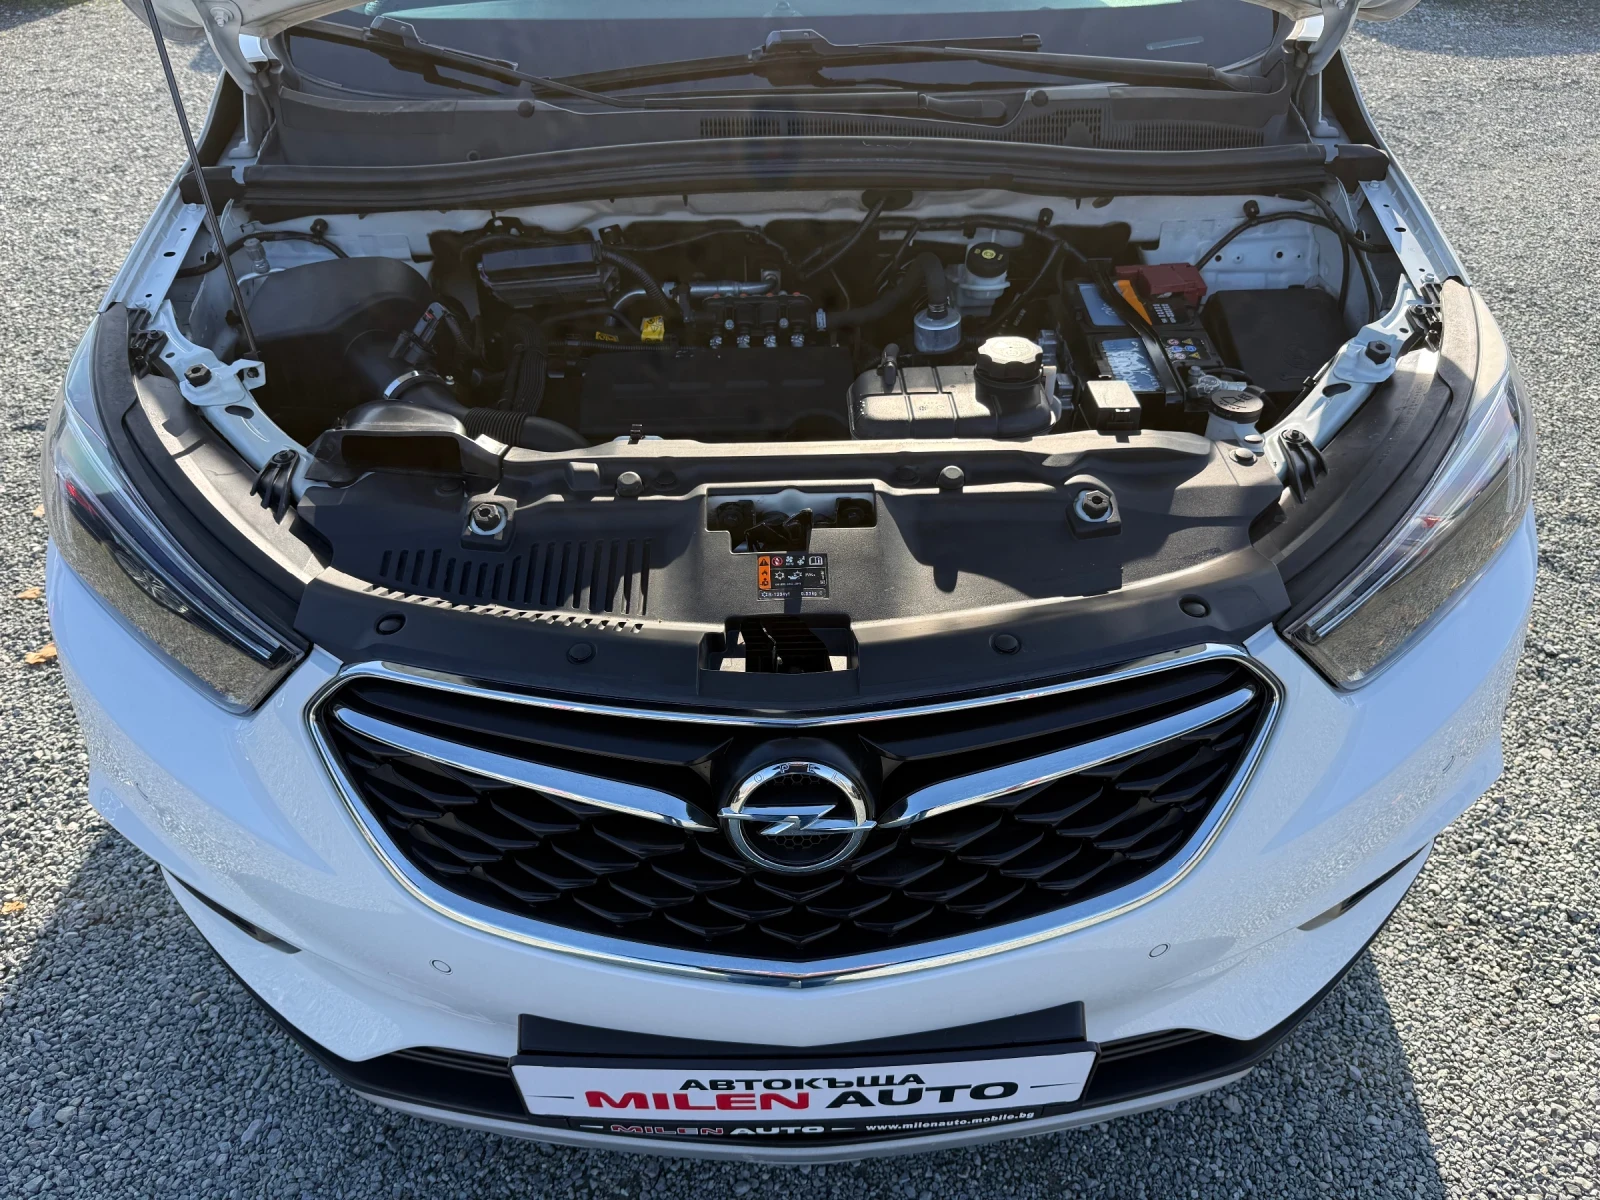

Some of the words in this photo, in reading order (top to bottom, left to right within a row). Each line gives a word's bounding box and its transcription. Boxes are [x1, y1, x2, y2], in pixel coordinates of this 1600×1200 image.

[753, 762, 839, 783] OPEL
[678, 1073, 926, 1091] АВТОКЪША
[585, 1091, 810, 1111] MILEN
[825, 1081, 1019, 1109] AUTO
[610, 1124, 724, 1135] MILEN
[729, 1126, 825, 1135] AUTO
[865, 1111, 1035, 1131] www.milenauto.mobile.bg
